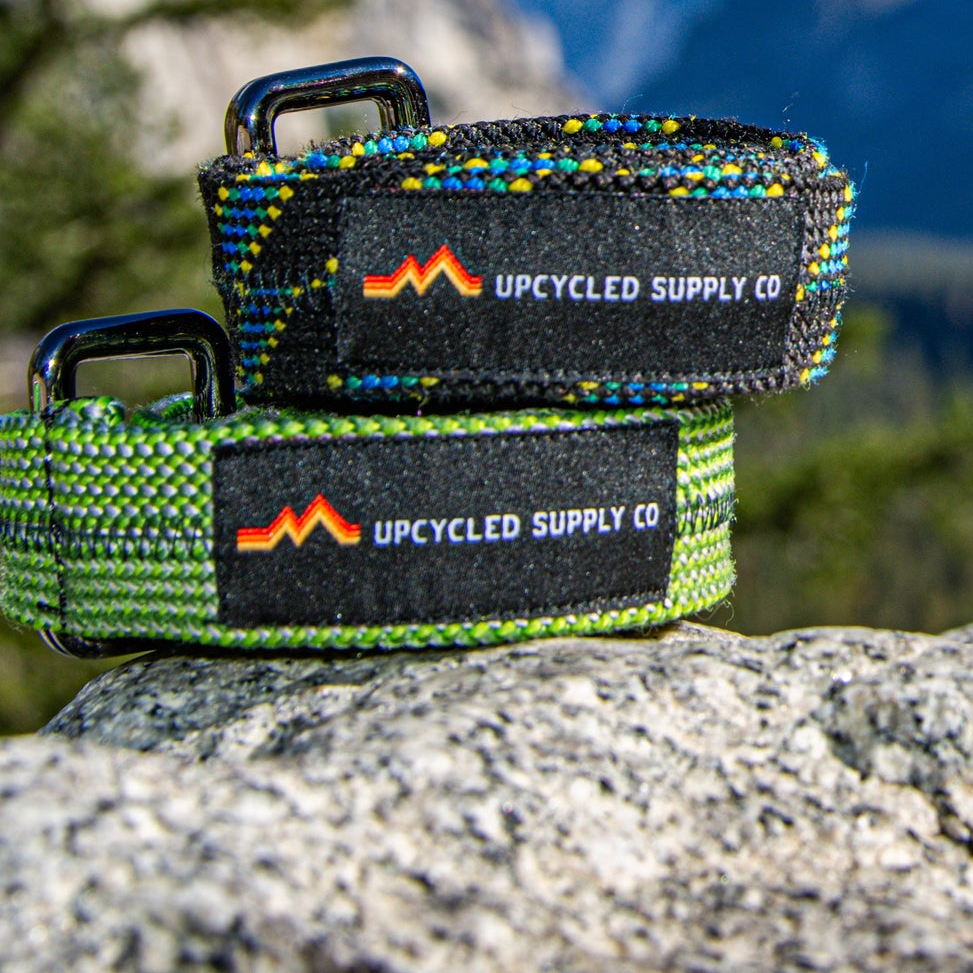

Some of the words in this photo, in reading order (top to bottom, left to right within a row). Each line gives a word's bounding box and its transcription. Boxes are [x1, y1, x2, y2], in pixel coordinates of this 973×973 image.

[495, 274, 640, 301] UPCYCLED
[651, 276, 746, 302] SUPPLY
[754, 275, 781, 300] CO
[374, 514, 520, 545] UPCYCLED
[531, 506, 625, 538] SUPPLY
[633, 502, 659, 530] CO
